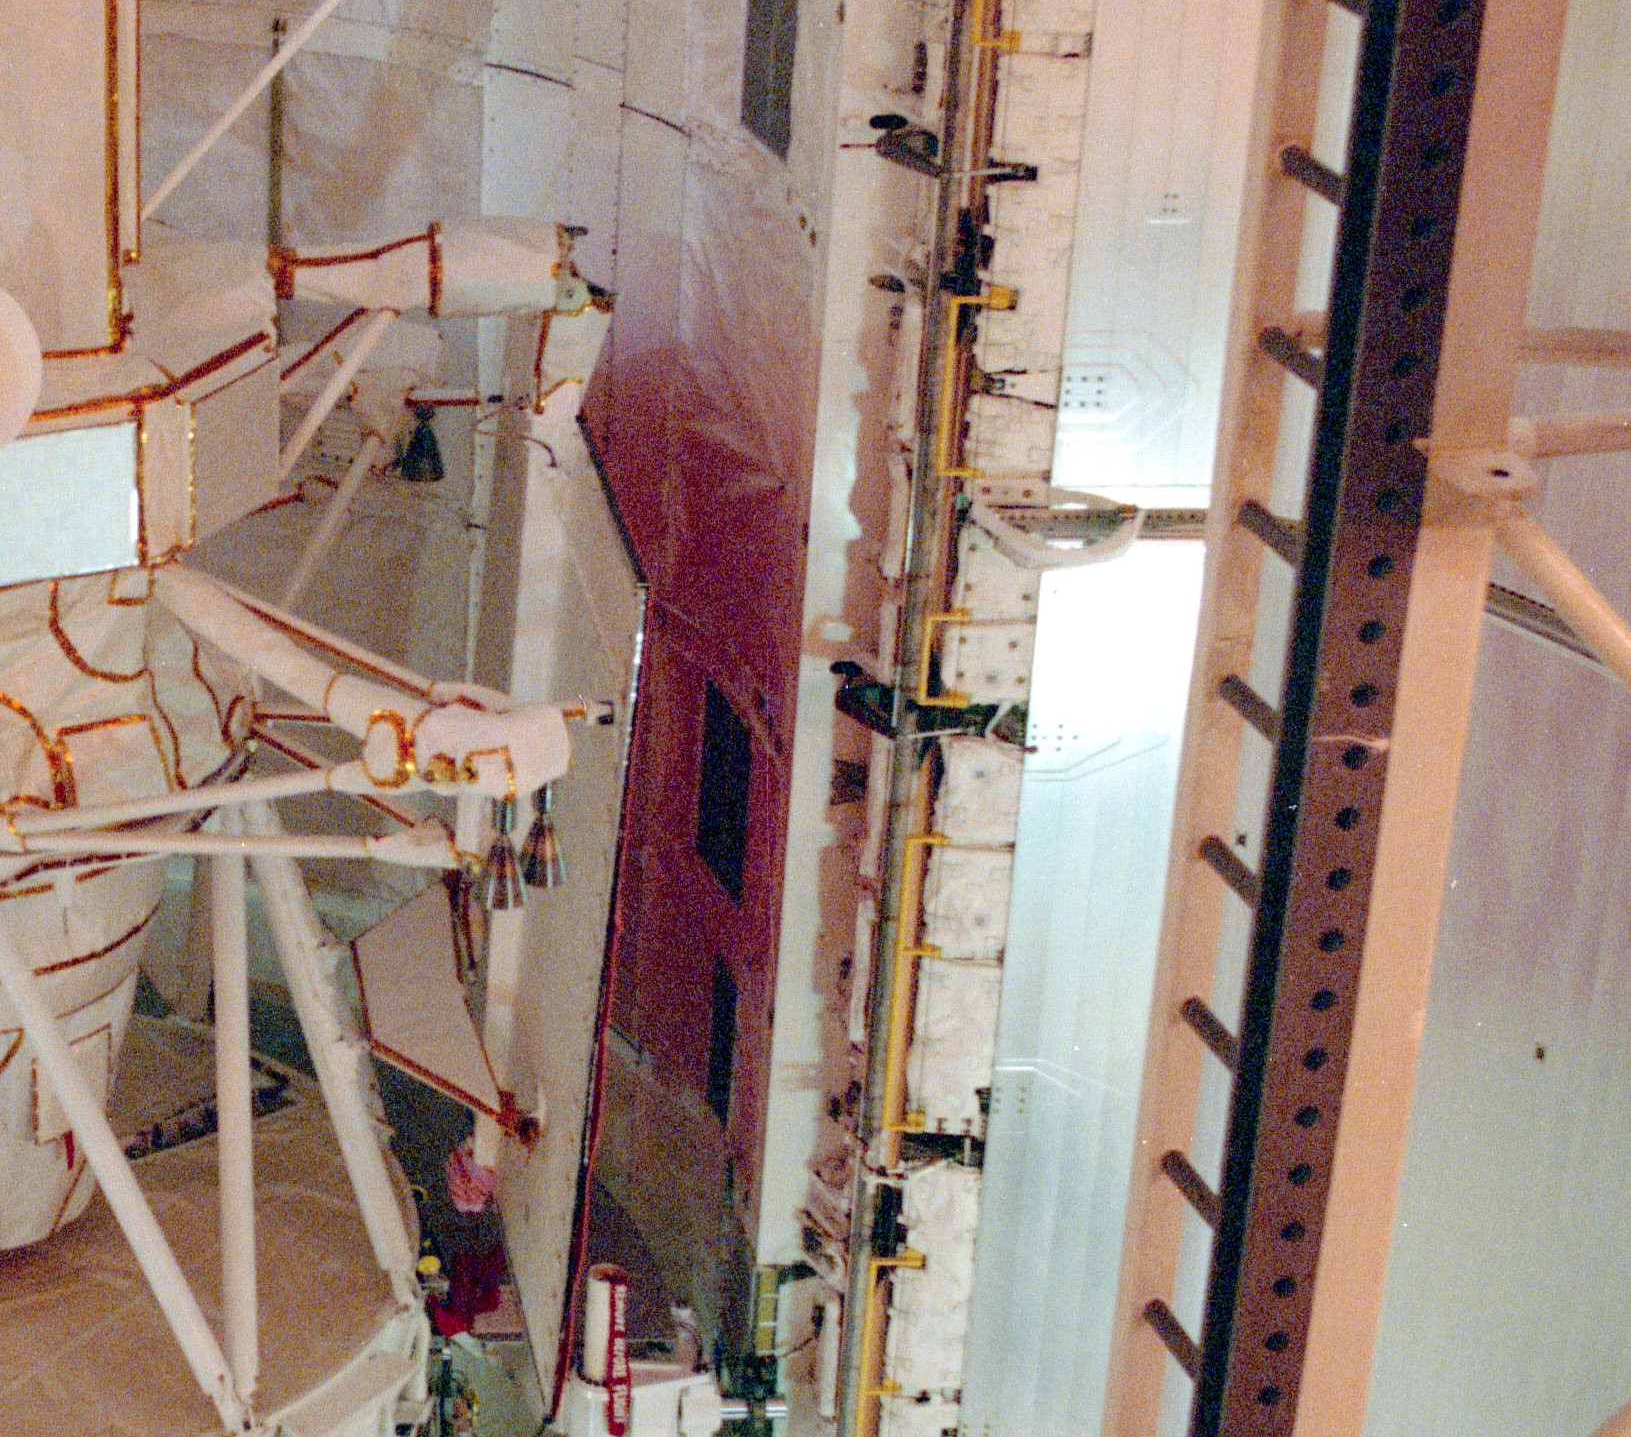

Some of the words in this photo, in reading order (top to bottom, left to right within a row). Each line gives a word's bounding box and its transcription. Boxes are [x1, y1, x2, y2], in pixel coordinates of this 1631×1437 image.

[614, 1284, 627, 1332] REMOVE
[612, 1338, 627, 1379] BEFORE
[612, 1384, 628, 1424] FLIGHT
